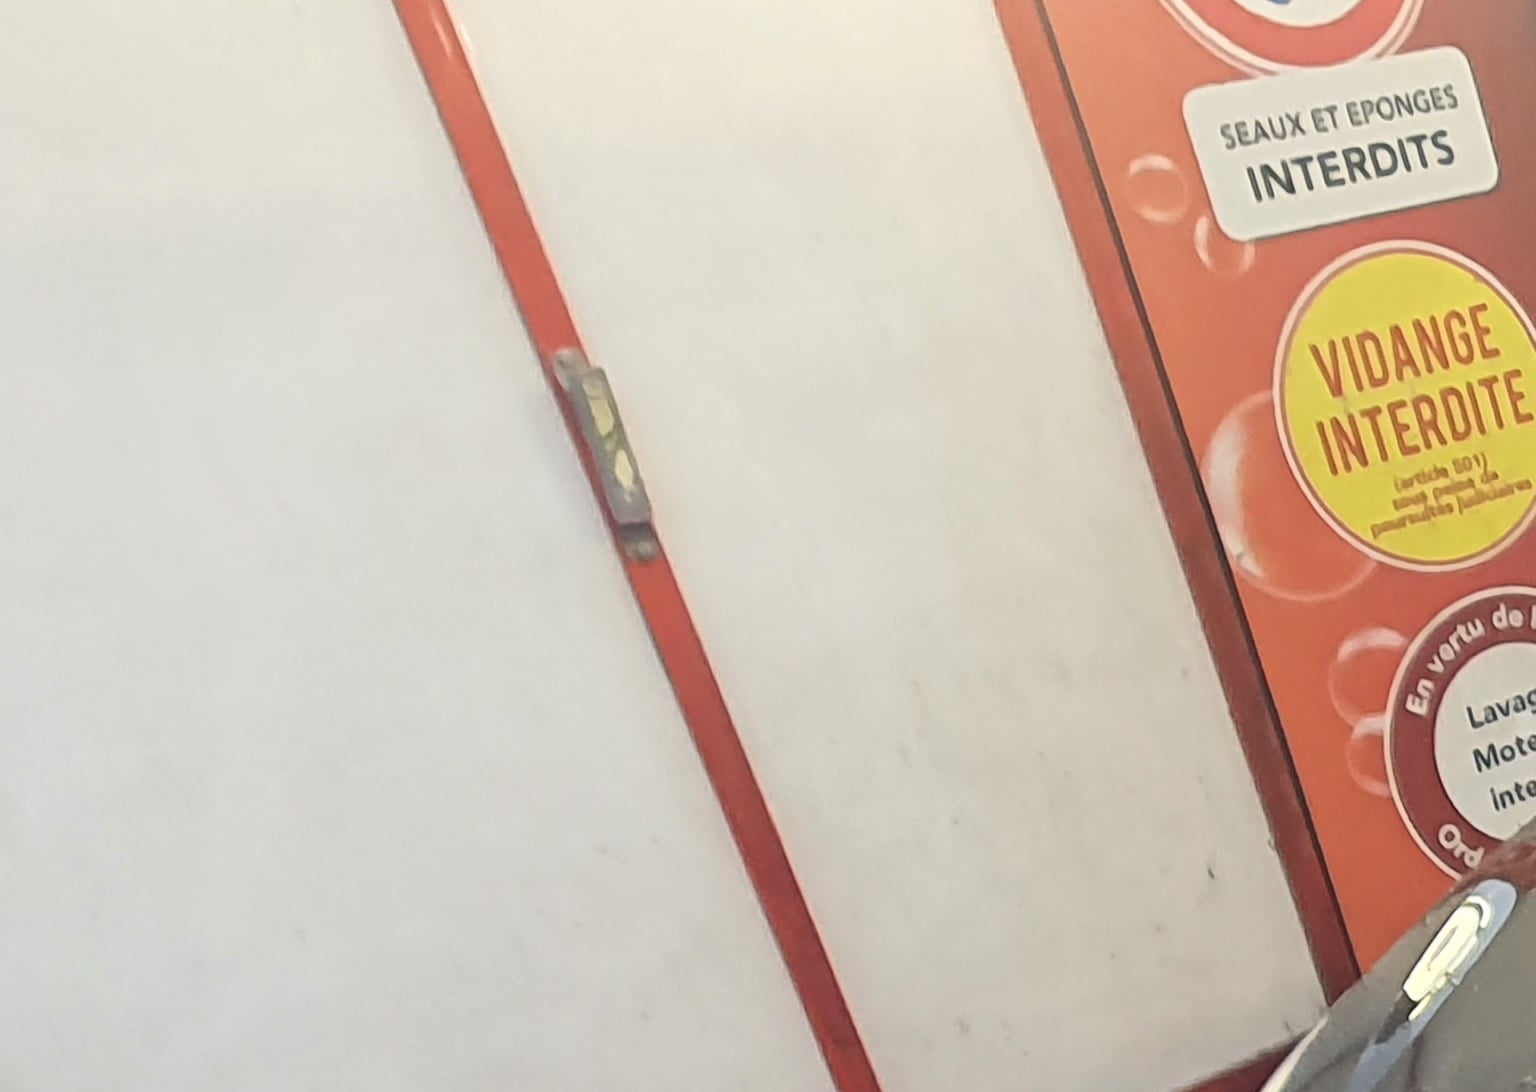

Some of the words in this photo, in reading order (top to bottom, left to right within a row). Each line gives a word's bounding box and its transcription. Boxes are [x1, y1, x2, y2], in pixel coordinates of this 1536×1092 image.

[1219, 112, 1306, 150] SEAUX
[1312, 105, 1340, 134] ET
[1347, 83, 1459, 127] EPONGES
[1247, 129, 1456, 203] INTERDITS
[1310, 302, 1500, 397] VIDANGE
[1315, 368, 1535, 476] INTERDITE
[1405, 678, 1436, 717] En
[1427, 618, 1485, 674] vertu
[1492, 602, 1524, 631] de
